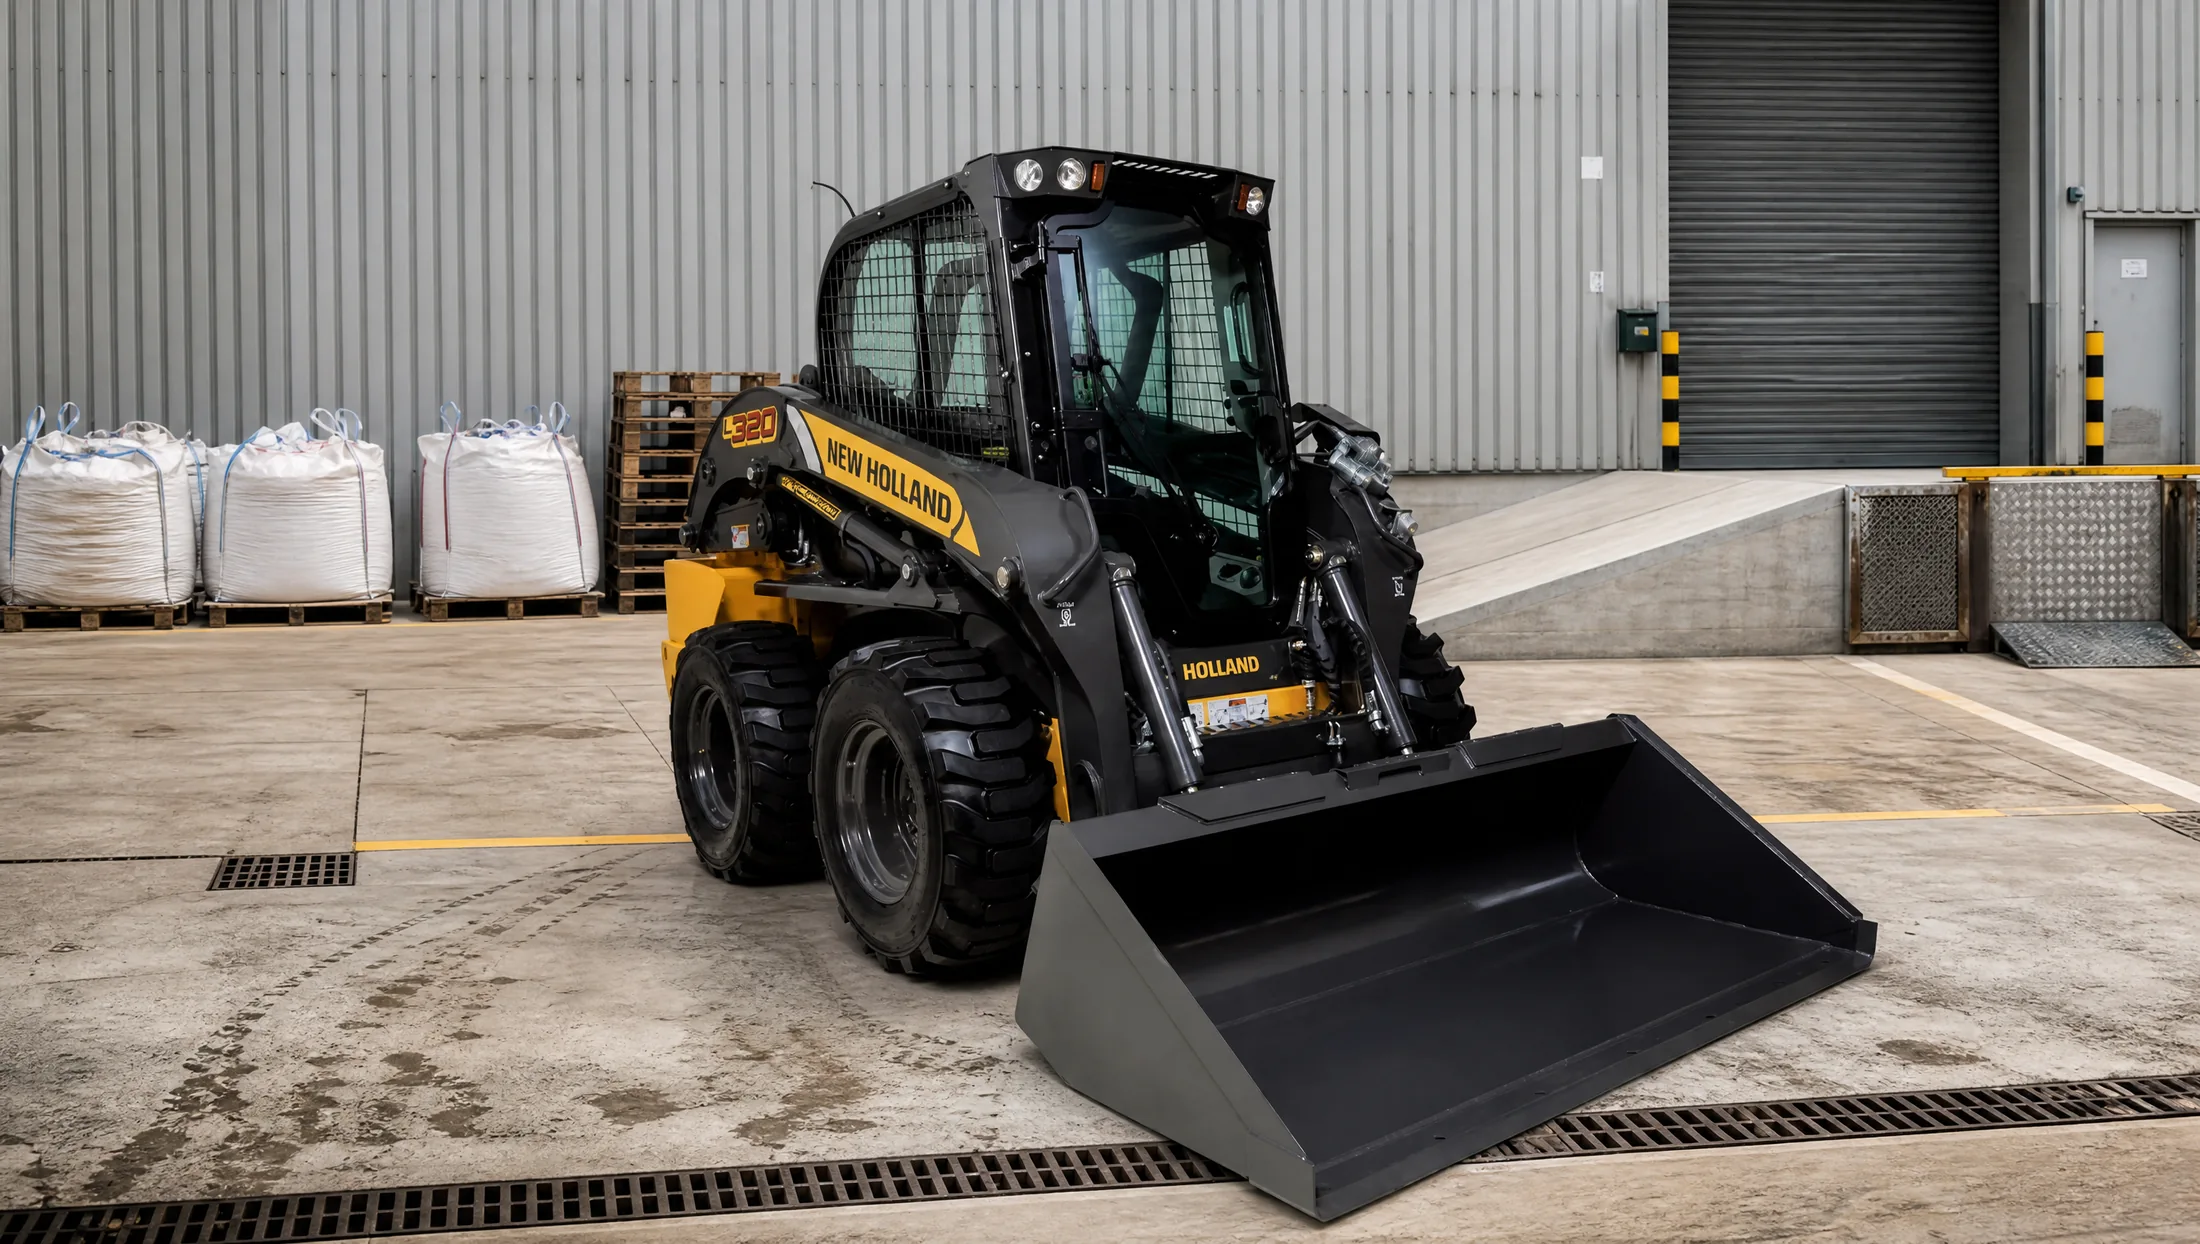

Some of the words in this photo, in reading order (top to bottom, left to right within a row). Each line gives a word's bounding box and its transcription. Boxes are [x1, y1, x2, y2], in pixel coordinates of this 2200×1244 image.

[723, 406, 778, 446] L320
[827, 437, 864, 478] NEW
[866, 456, 952, 524] HOLLAND
[1182, 655, 1260, 681] HOLLAND
